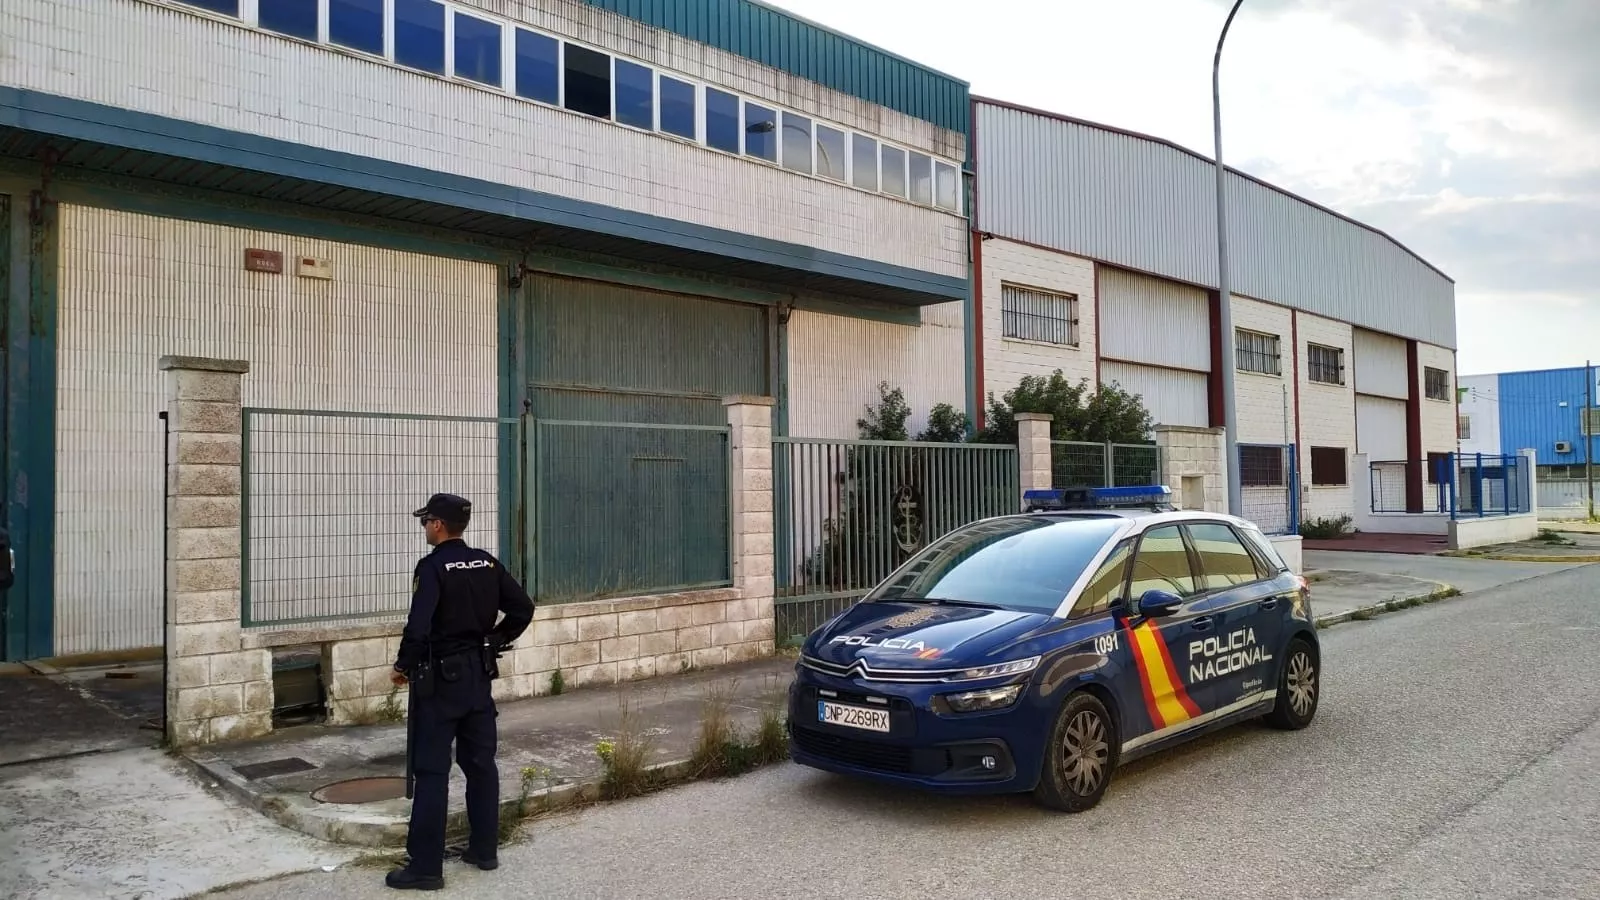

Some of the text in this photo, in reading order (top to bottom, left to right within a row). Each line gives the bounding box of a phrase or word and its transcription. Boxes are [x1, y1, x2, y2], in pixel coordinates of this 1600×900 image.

[445, 560, 491, 571] POLICIA
[828, 635, 925, 652] POLICIA
[1100, 632, 1119, 654] 091
[1190, 645, 1273, 684] NACIONAL
